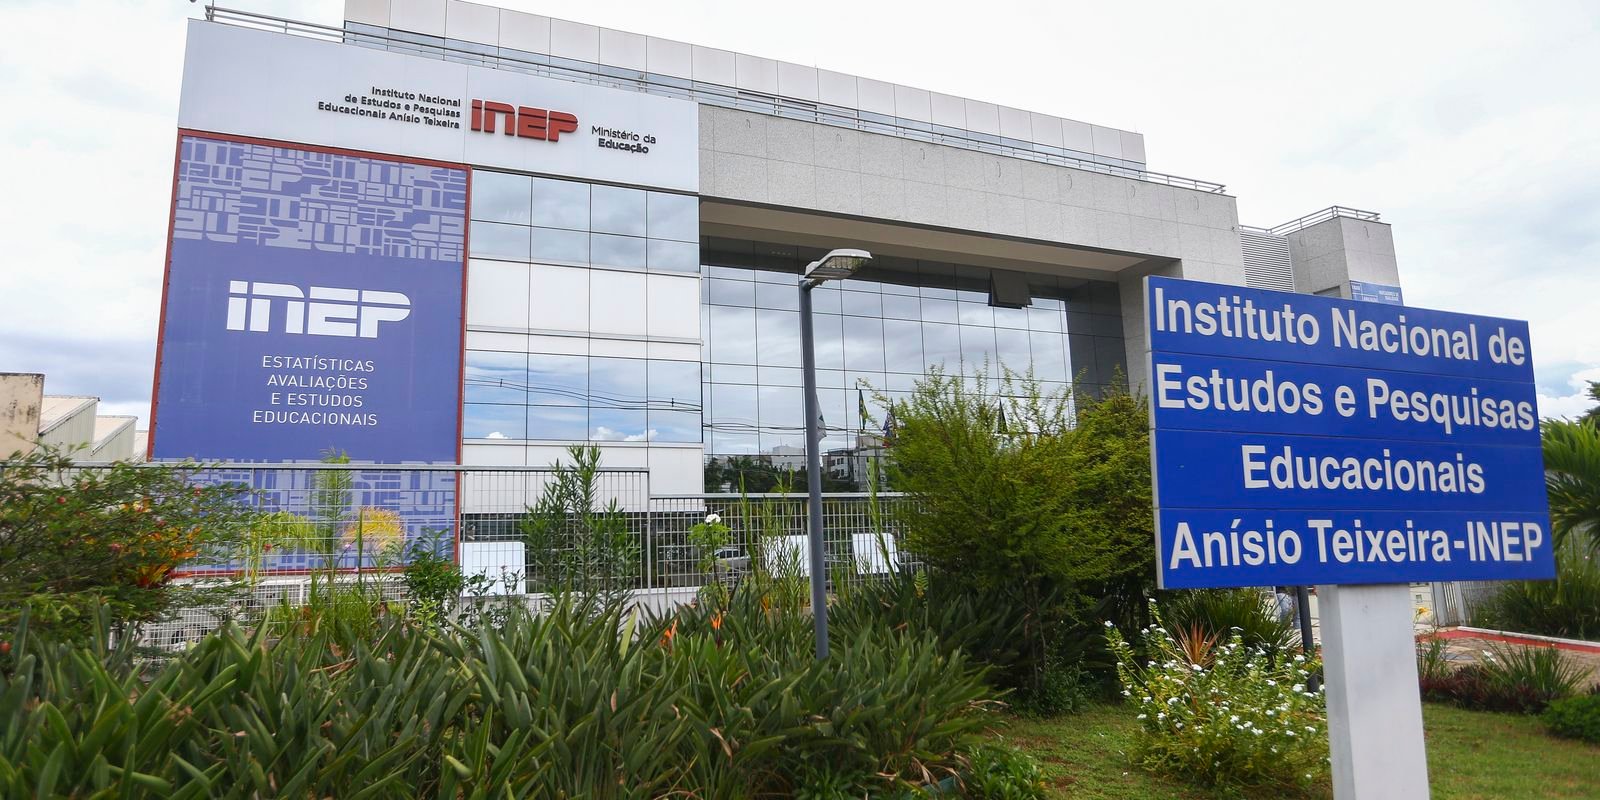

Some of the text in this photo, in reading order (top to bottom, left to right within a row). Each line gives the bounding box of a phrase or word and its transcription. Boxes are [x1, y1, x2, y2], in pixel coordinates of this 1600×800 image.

[344, 94, 461, 119] de Estudos e Pesquisas
[371, 86, 461, 108] Instituto Nacional
[318, 101, 460, 130] Educacionais Anísio Teixeira
[591, 125, 657, 145] Ministério da
[598, 138, 649, 155] Educação
[1155, 287, 1525, 366] Instituto Nacional de
[262, 354, 375, 372] ESTATÍSTICAS
[267, 374, 368, 392] AVALIAÇÕES
[271, 392, 363, 408] E ESTUDOS
[1156, 363, 1535, 435] Estudos e Pesquisas
[252, 410, 378, 426] EDUCACIONAIS
[1242, 444, 1485, 494] Educacionais
[1170, 518, 1543, 570] Anísio Teixeira-INEP
